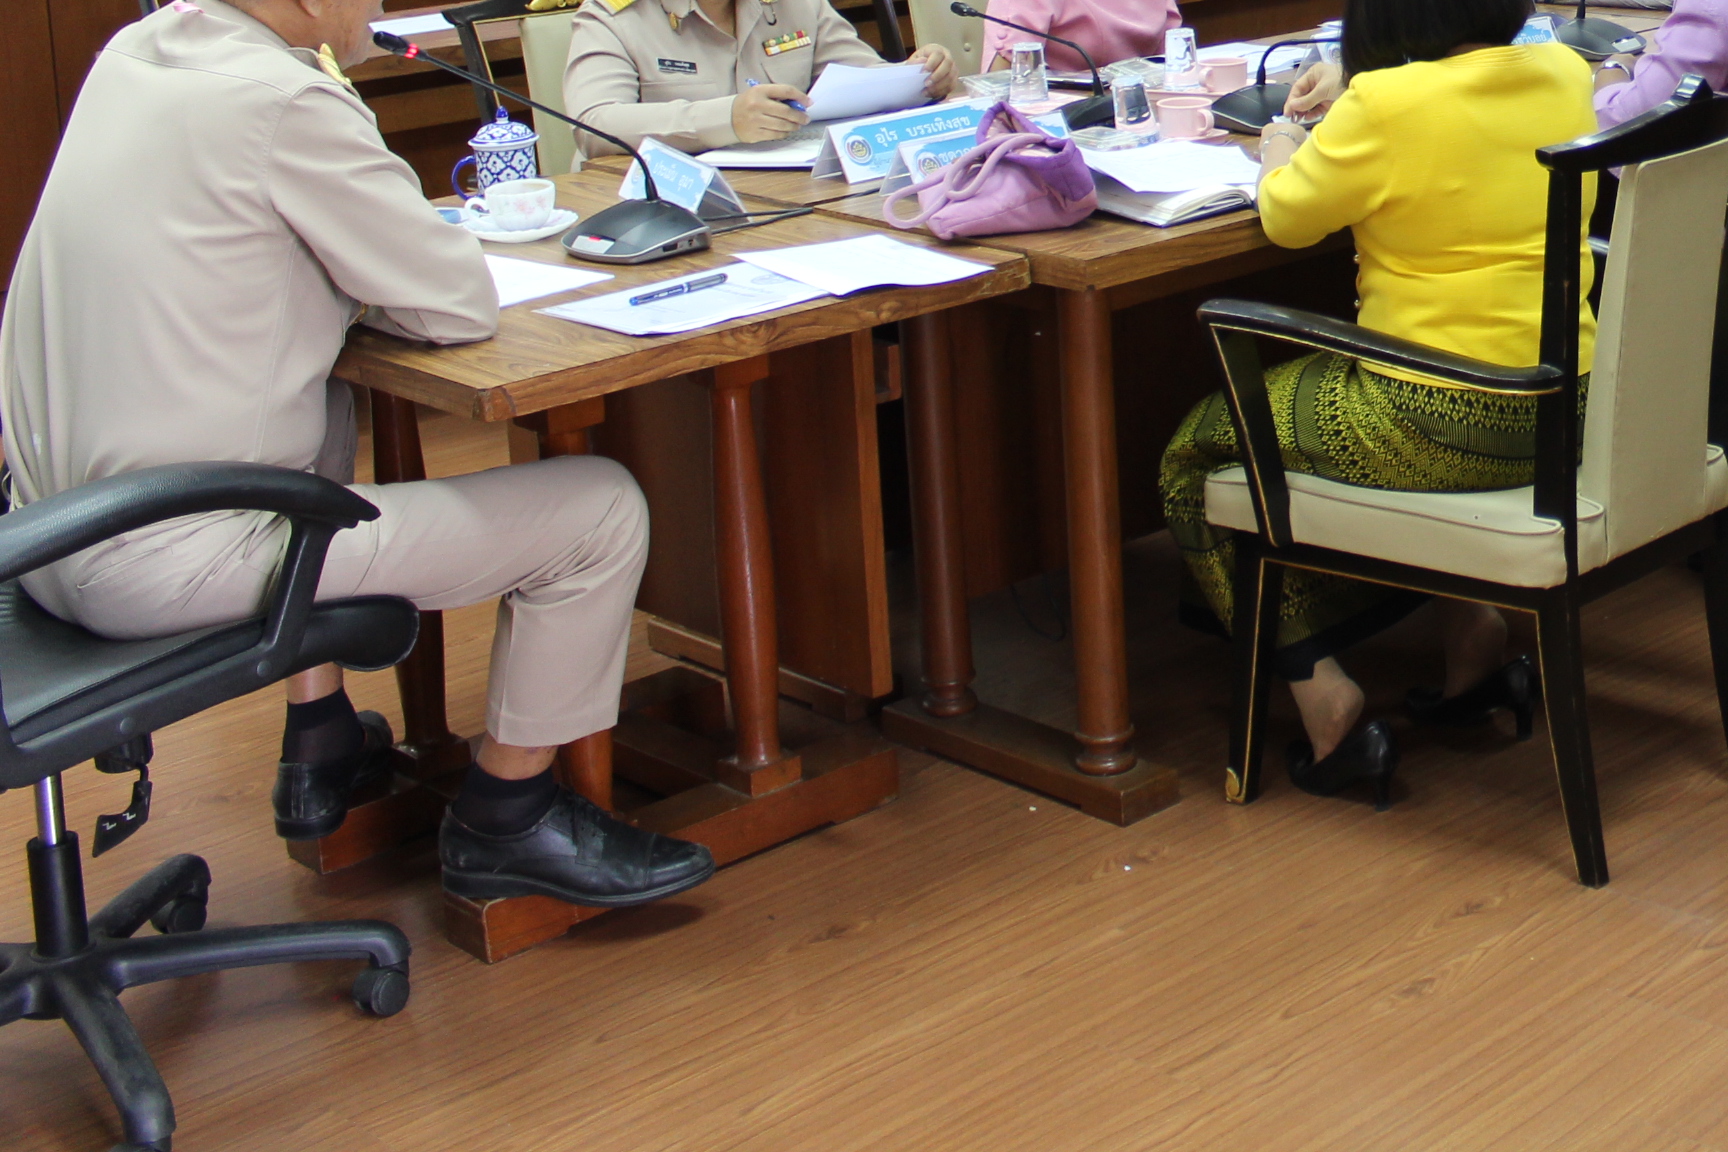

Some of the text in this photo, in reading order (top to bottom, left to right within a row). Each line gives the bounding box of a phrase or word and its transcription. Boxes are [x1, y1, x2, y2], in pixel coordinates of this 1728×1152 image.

[874, 115, 971, 147] อุไร บรรเทิงสุข
